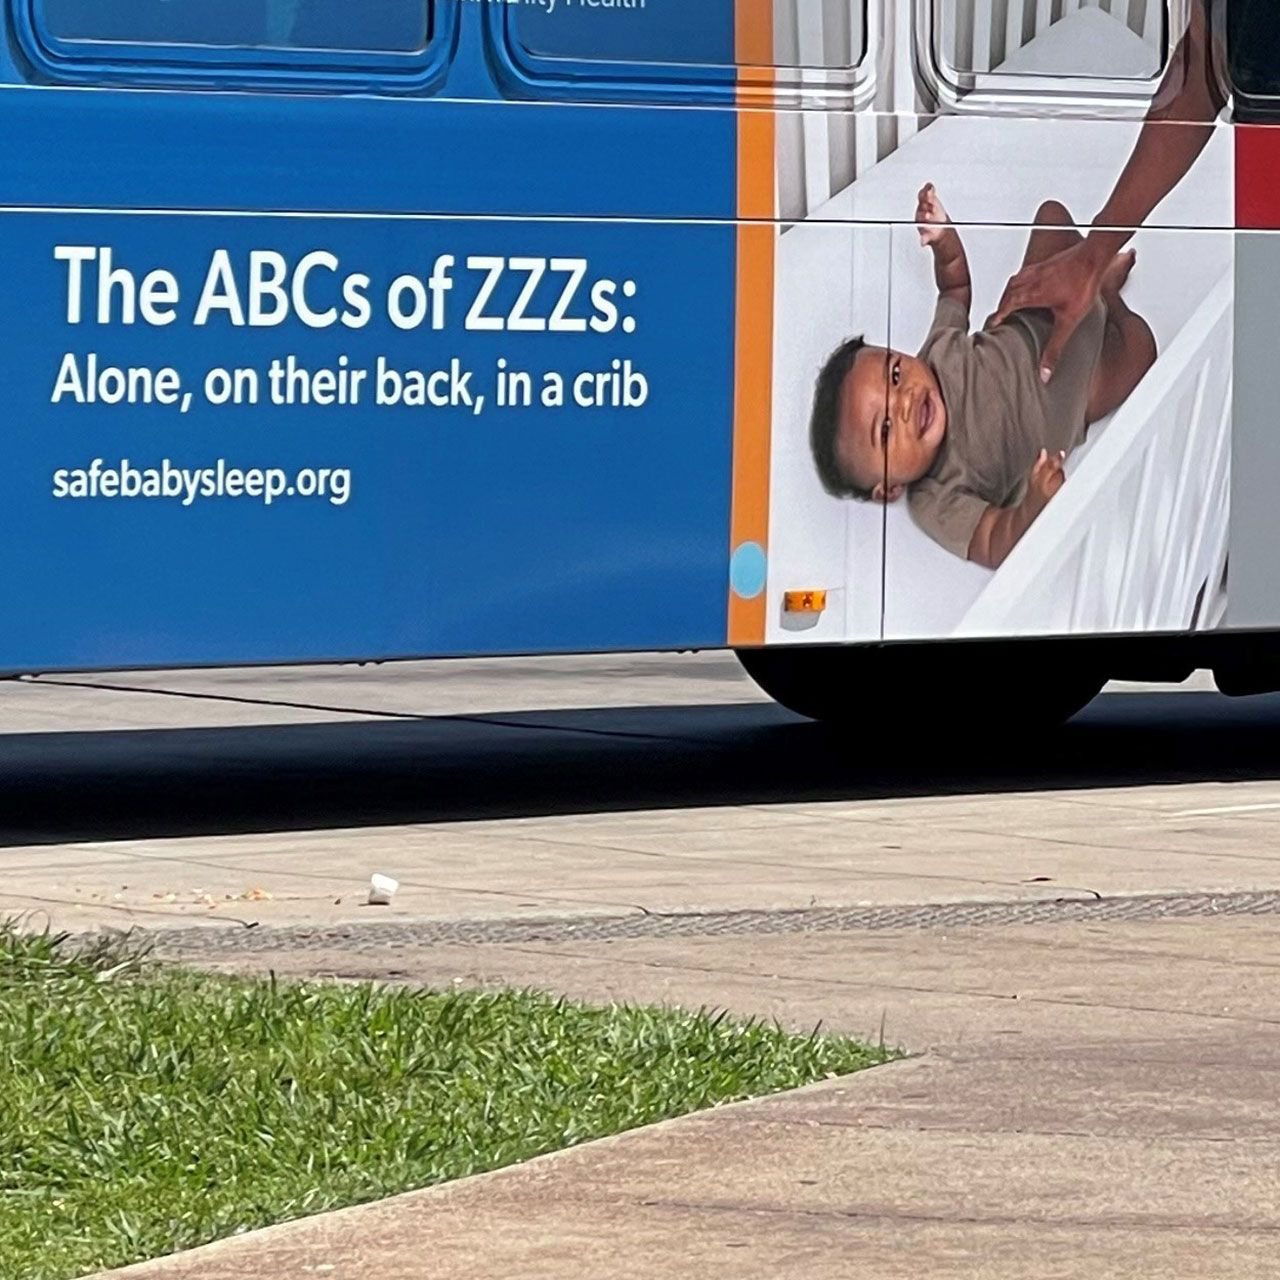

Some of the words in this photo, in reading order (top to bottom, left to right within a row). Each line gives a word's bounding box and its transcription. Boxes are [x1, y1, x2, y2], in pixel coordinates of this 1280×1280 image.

[54, 246, 179, 326] The
[193, 249, 372, 329] ABCs
[388, 254, 455, 331] of
[465, 256, 637, 334] ZZZs:
[51, 353, 193, 414] Alone,
[205, 368, 259, 405] on
[268, 355, 367, 406] their
[376, 356, 485, 415] back,
[496, 358, 532, 407] in
[541, 372, 565, 408] a
[573, 359, 649, 408] crib
[52, 458, 352, 507] safebabysleep.org
